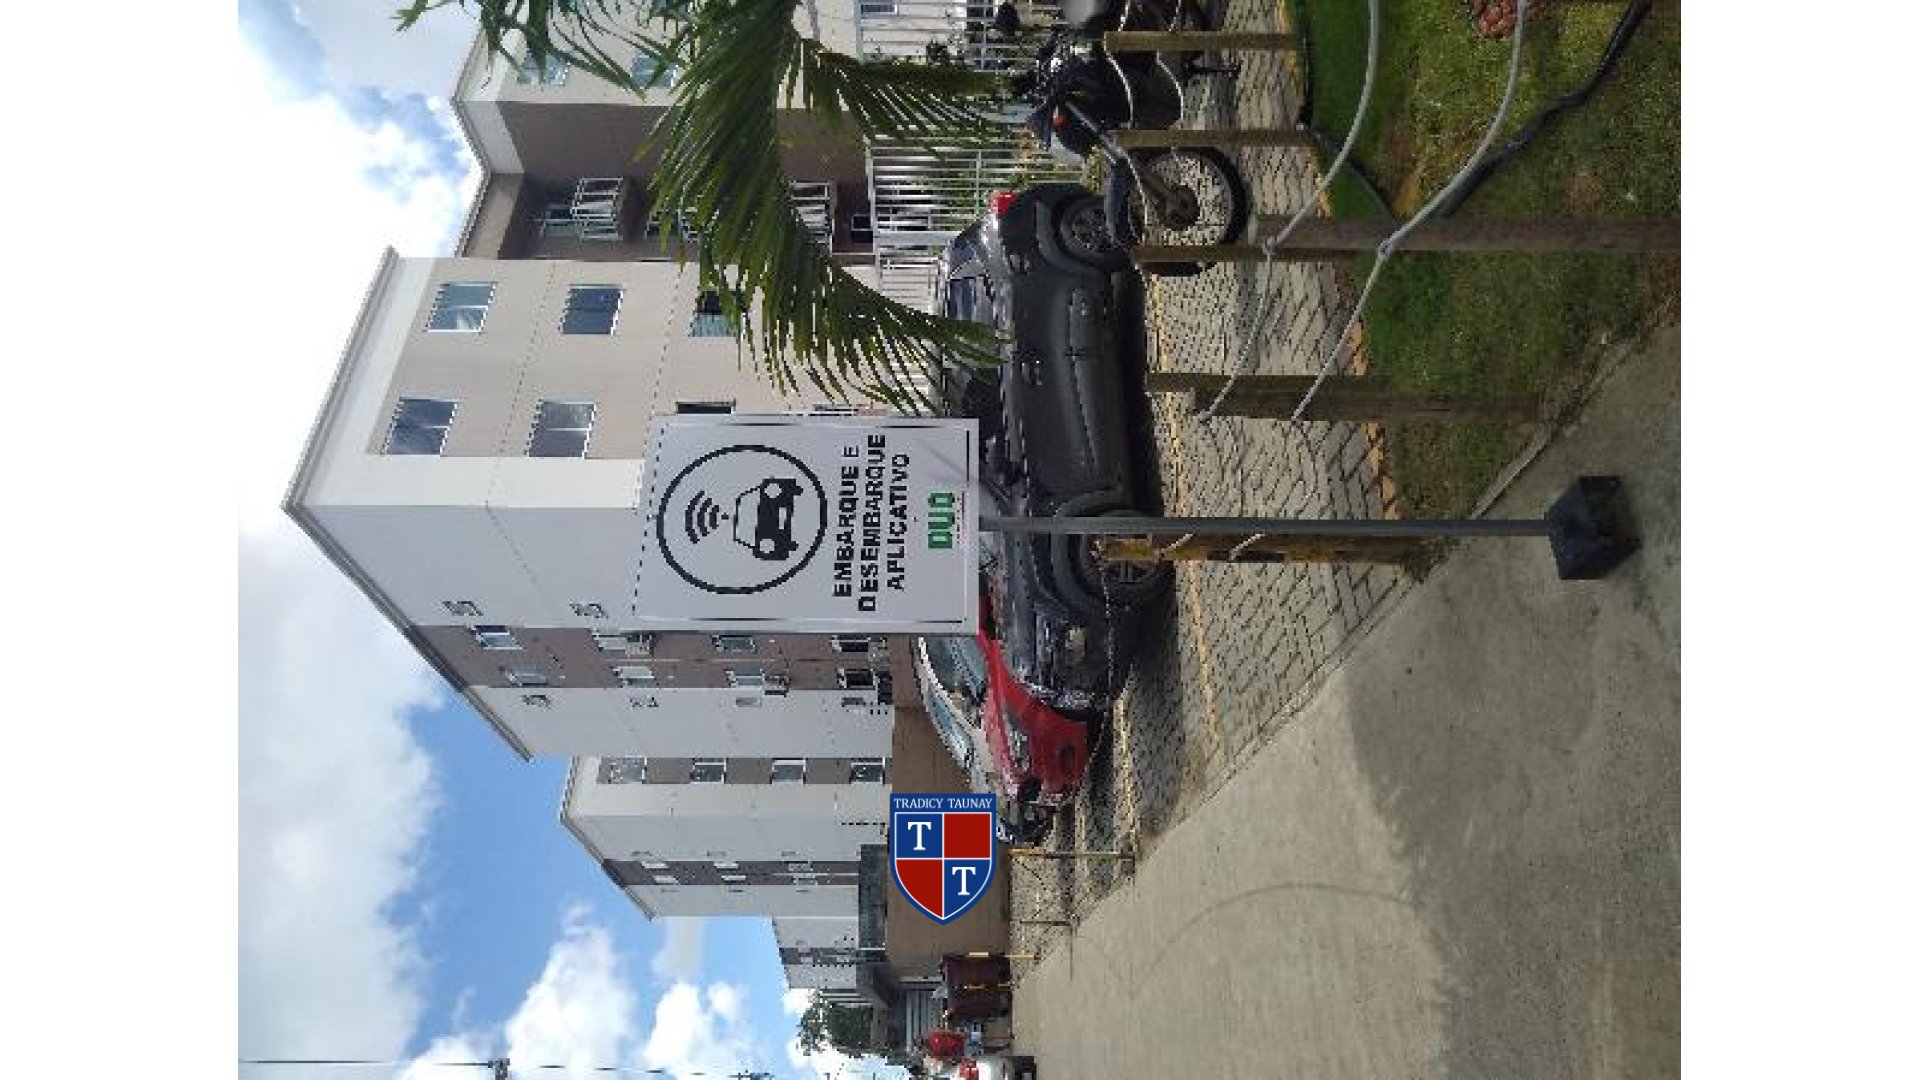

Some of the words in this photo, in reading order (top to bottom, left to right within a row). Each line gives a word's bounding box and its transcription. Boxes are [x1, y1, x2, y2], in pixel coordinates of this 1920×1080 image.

[843, 445, 859, 458] E
[832, 466, 859, 597] EMBARQUE
[858, 434, 886, 612] DESEMBARQUE
[886, 454, 910, 592] APLICATIVO
[927, 492, 956, 549] DUO
